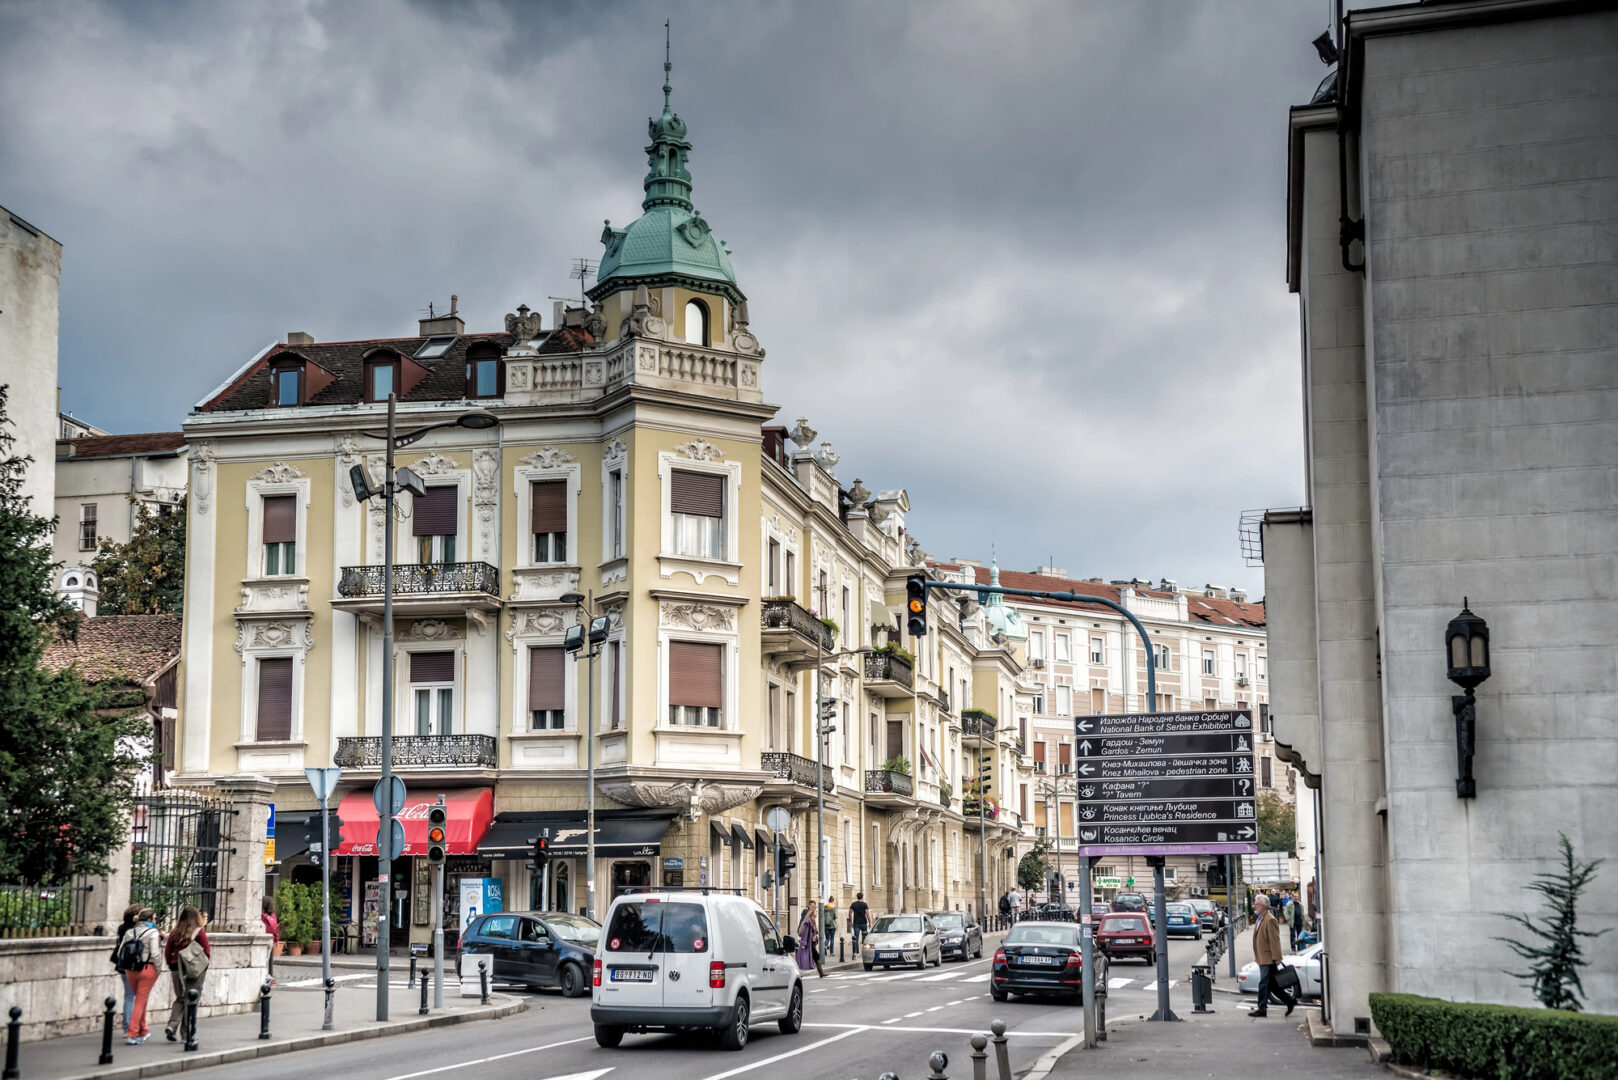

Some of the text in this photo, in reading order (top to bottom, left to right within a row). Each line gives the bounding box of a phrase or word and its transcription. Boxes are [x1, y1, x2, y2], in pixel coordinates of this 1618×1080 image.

[1100, 713, 1229, 725] Изложба Народне банке Србије
[1100, 722, 1231, 734] National Bank of Serbia Exhibition
[1101, 739, 1133, 748] Гардош
[1139, 738, 1165, 747] Земун
[1101, 747, 1129, 755] Gardos
[1135, 746, 1162, 754] Zemun
[1209, 758, 1228, 766] зона
[1102, 769, 1122, 777] Knez
[1123, 768, 1159, 776] Mihailova
[1165, 767, 1207, 776] pedestrian
[1102, 782, 1135, 791] Кафана
[1115, 790, 1142, 798] Tavern
[1103, 804, 1128, 812] Конак
[1103, 813, 1137, 821] Princess
[1138, 812, 1173, 821] Ljubica's
[1104, 826, 1178, 834] Косанчићев венац
[1104, 834, 1165, 843] Kosancic Circle
[487, 885, 501, 897] ROSA
